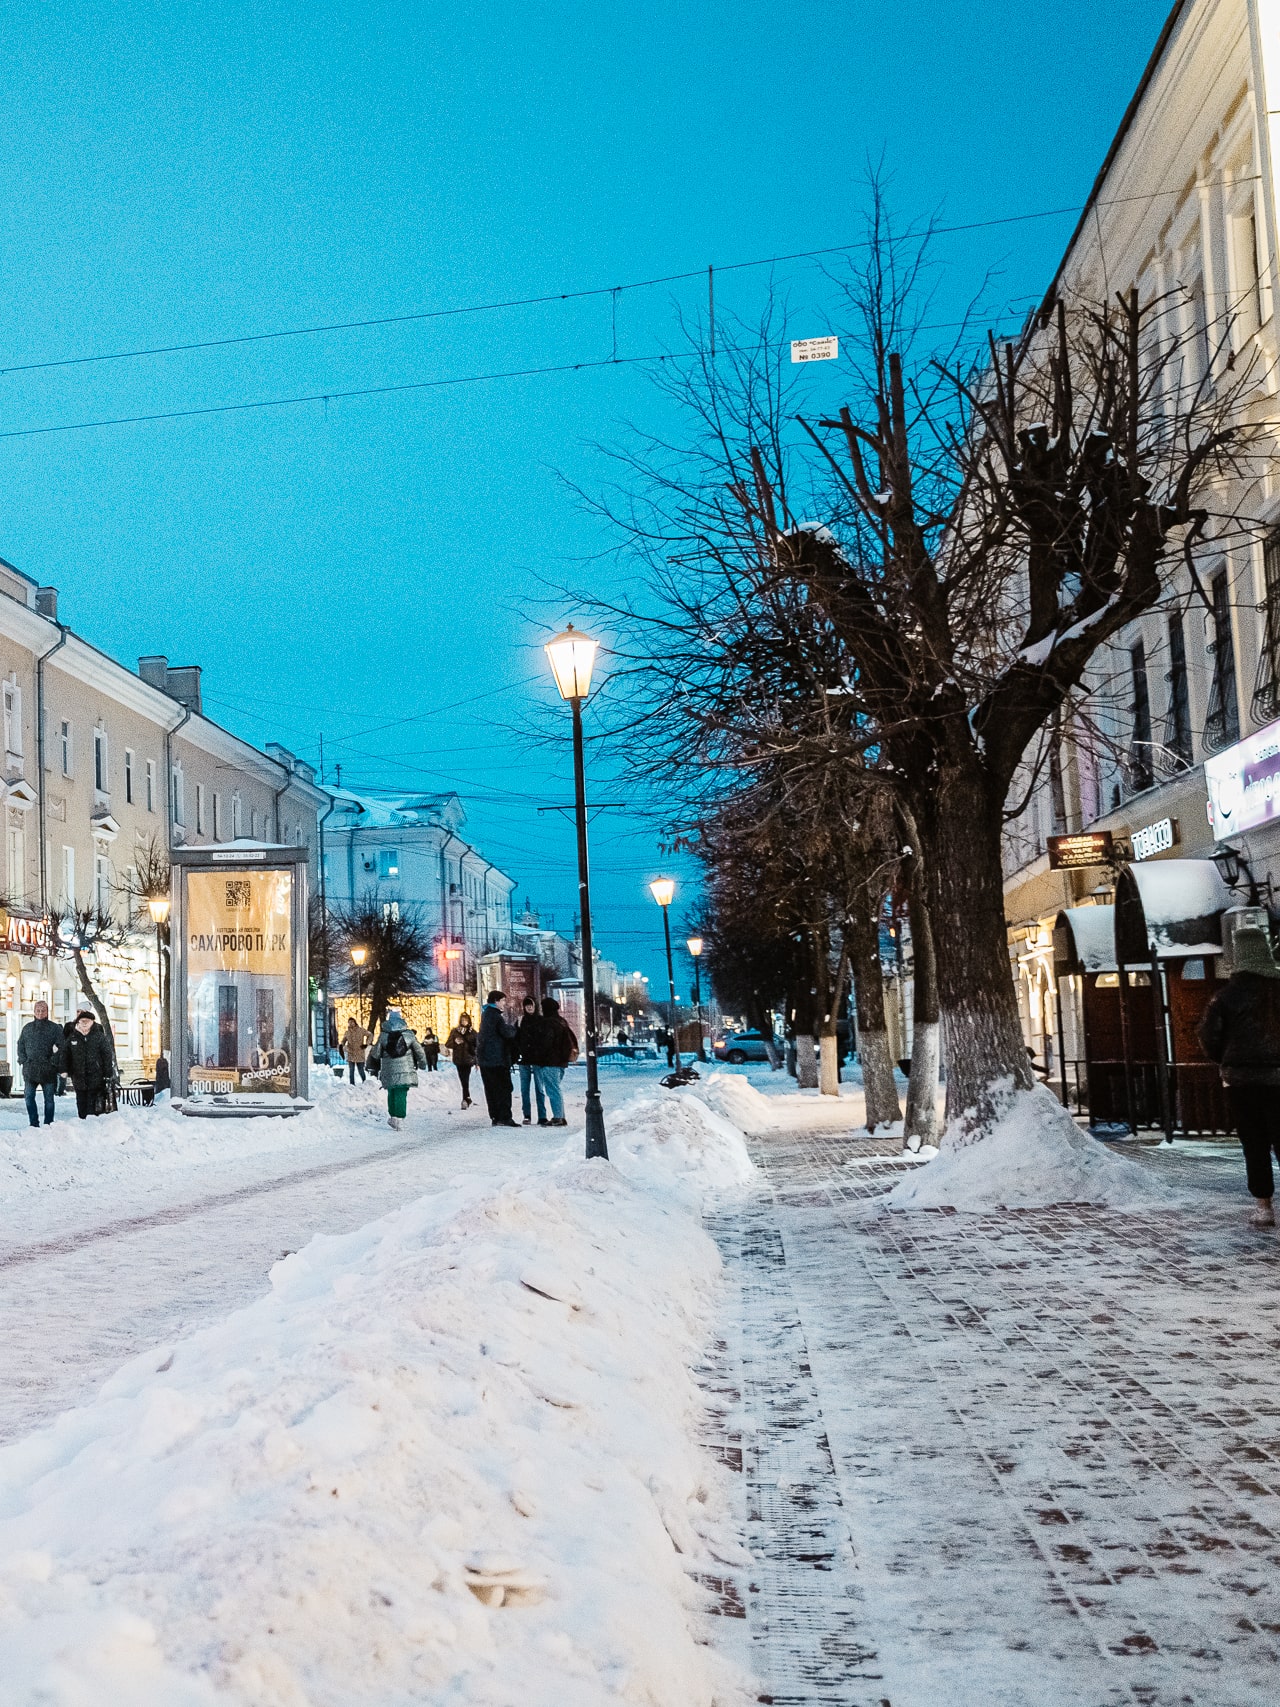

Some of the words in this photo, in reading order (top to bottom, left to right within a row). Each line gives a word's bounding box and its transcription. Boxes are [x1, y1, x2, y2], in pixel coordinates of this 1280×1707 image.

[1131, 818, 1173, 861] TOBACCO
[1057, 856, 1106, 866] АКСЕССУАР
[190, 934, 253, 951] САХАРОВО
[256, 933, 286, 951] ПАРК
[192, 1080, 212, 1093] 600
[214, 1081, 234, 1093] 080
